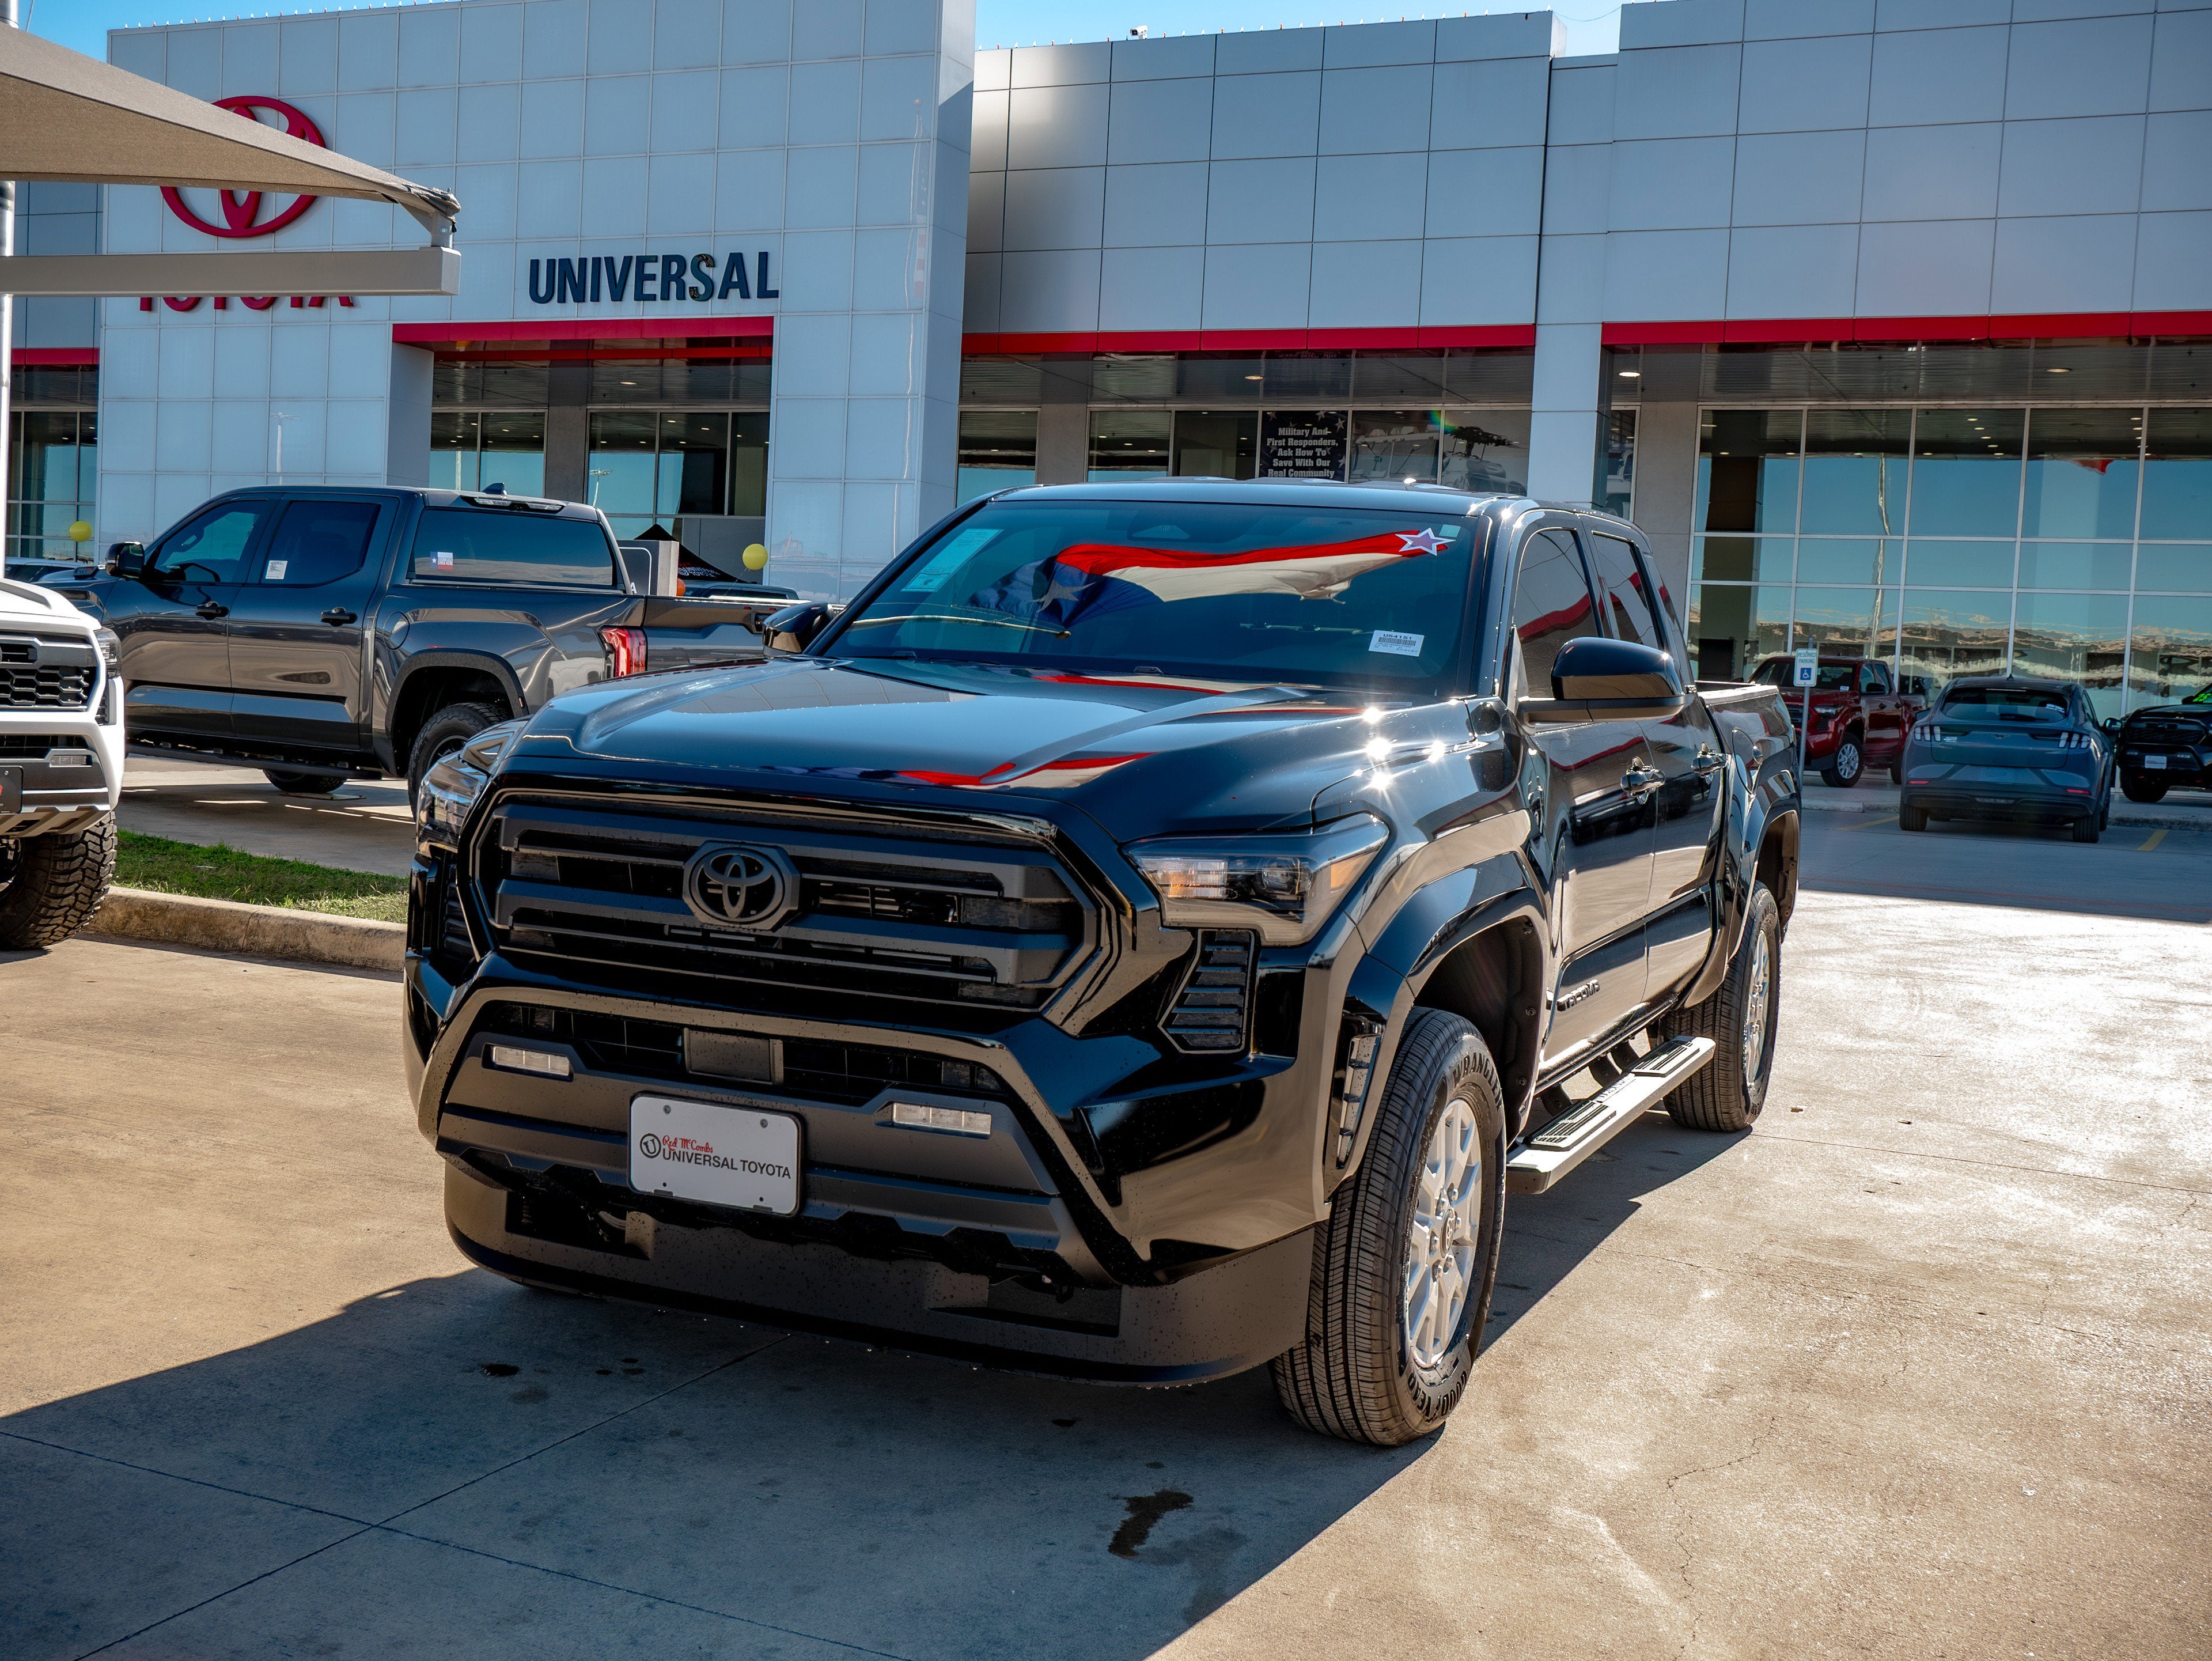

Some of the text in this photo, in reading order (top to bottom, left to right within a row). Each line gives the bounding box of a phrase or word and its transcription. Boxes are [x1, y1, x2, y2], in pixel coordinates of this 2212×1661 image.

[529, 251, 779, 304] UNIVERSAL
[1278, 427, 1328, 437] Military And
[1267, 438, 1338, 448] First Responders,
[1277, 448, 1327, 456] Ask How To
[1272, 459, 1331, 467] Save With Our
[1268, 468, 1335, 479] Real Community
[1453, 1052, 1502, 1112] WRANGLER
[662, 1135, 713, 1153] Red McCombs
[662, 1148, 791, 1179] UNIVERSAL TOYOTA
